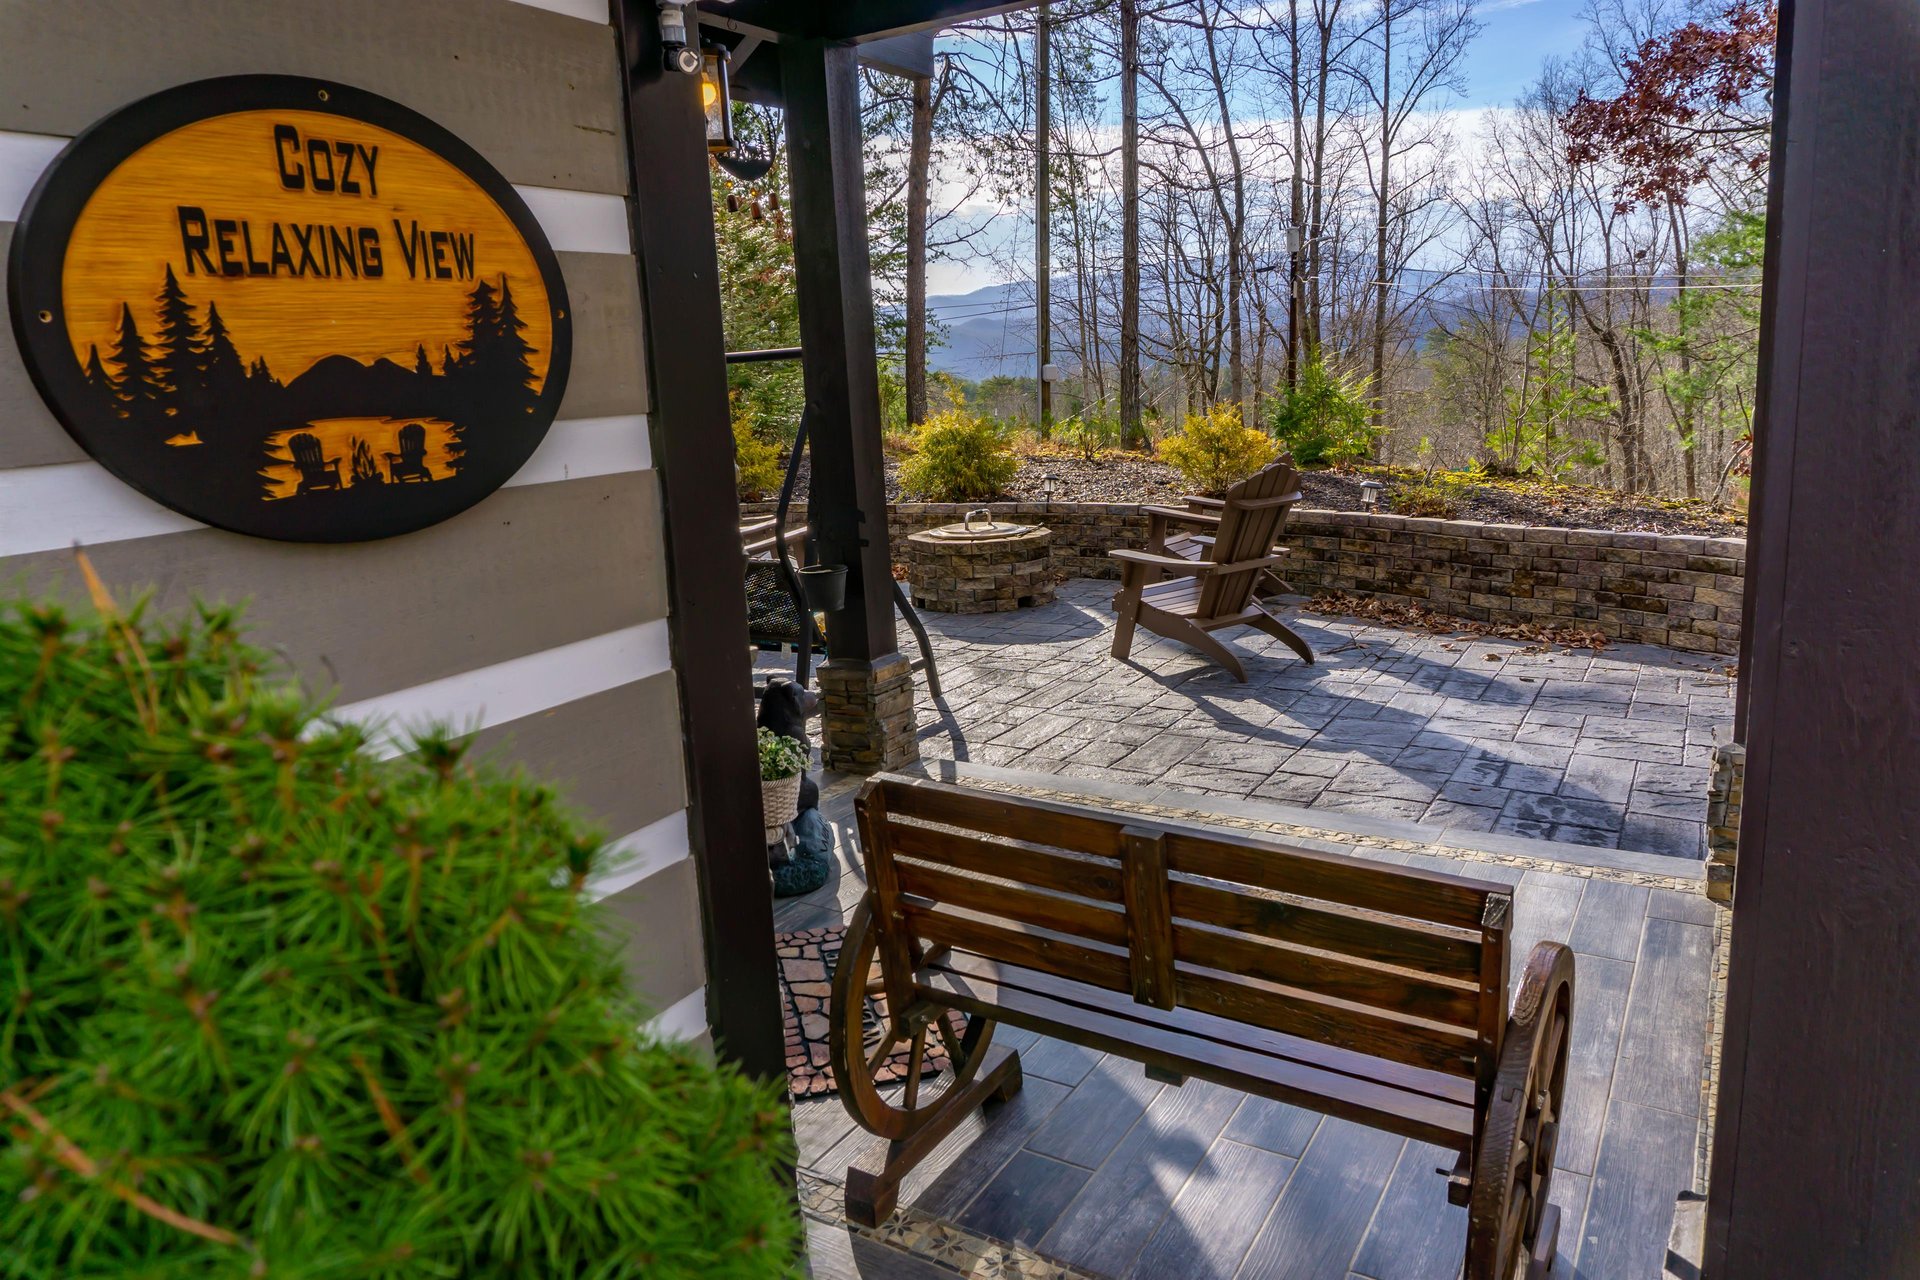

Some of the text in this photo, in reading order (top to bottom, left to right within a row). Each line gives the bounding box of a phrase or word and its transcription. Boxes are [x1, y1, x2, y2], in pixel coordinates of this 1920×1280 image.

[274, 124, 378, 195] COZY
[177, 206, 474, 280] RELAXING VIEW
